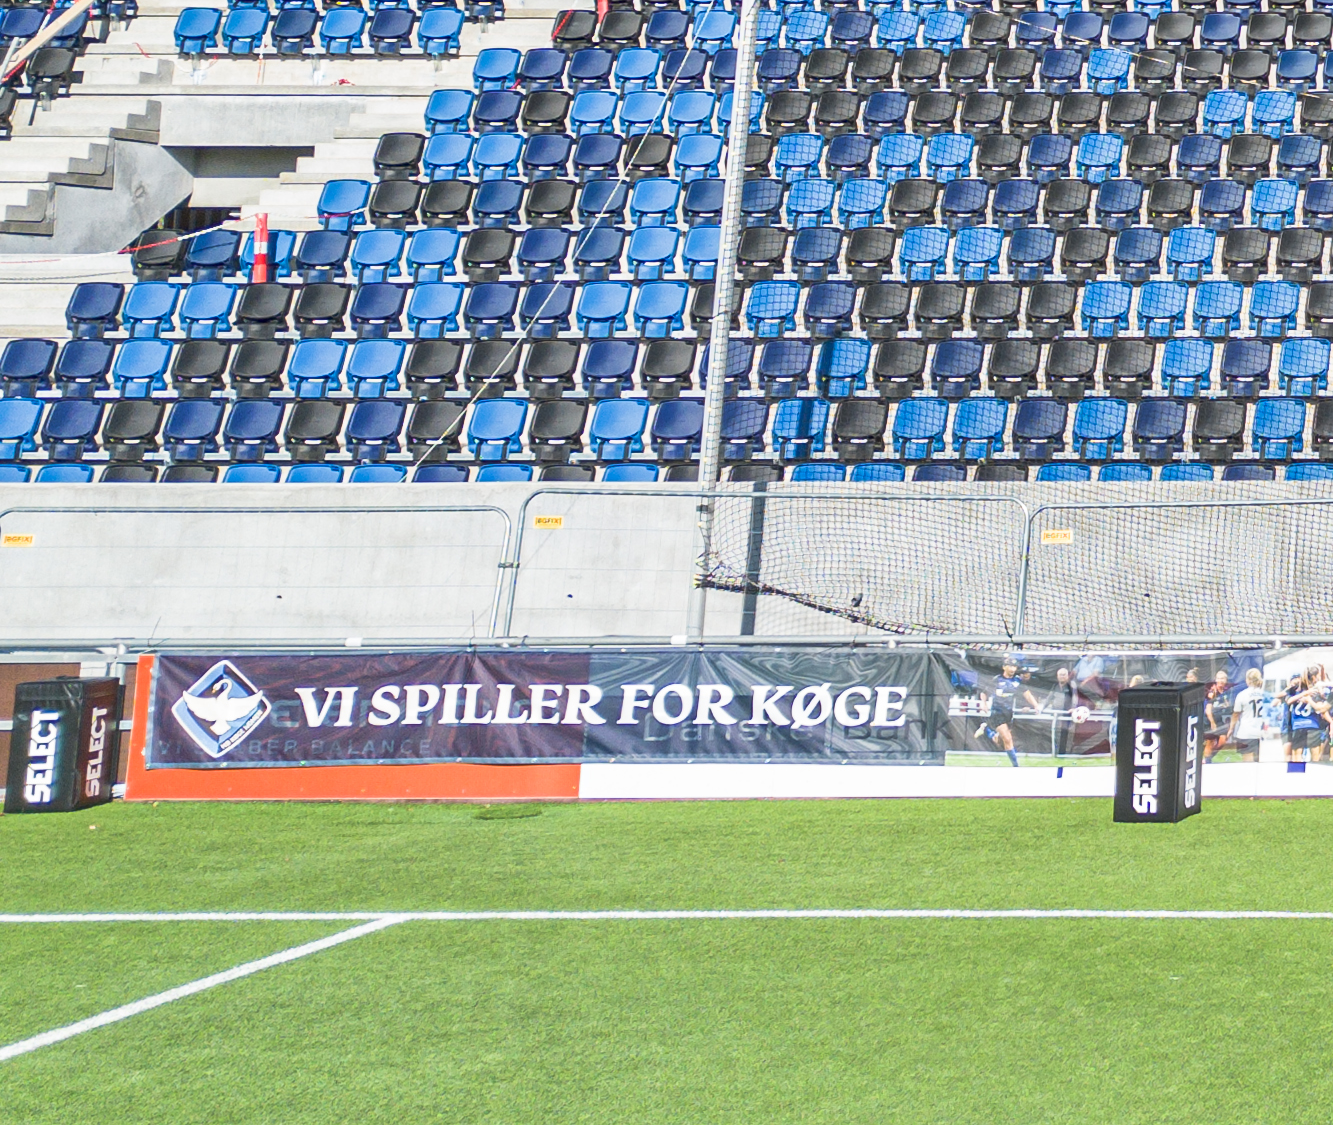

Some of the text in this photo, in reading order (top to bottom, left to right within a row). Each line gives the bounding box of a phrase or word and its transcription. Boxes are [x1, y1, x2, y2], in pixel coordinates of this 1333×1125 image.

[294, 686, 359, 727] VI
[367, 683, 607, 726] SPILLER
[617, 683, 739, 726] FOR
[748, 681, 907, 730] KØGE
[311, 739, 432, 755] BALANCE
[24, 709, 59, 804] SELECT
[85, 707, 107, 797] SELECT
[1133, 718, 1161, 814] SELECT
[1184, 715, 1198, 809] SELECT
